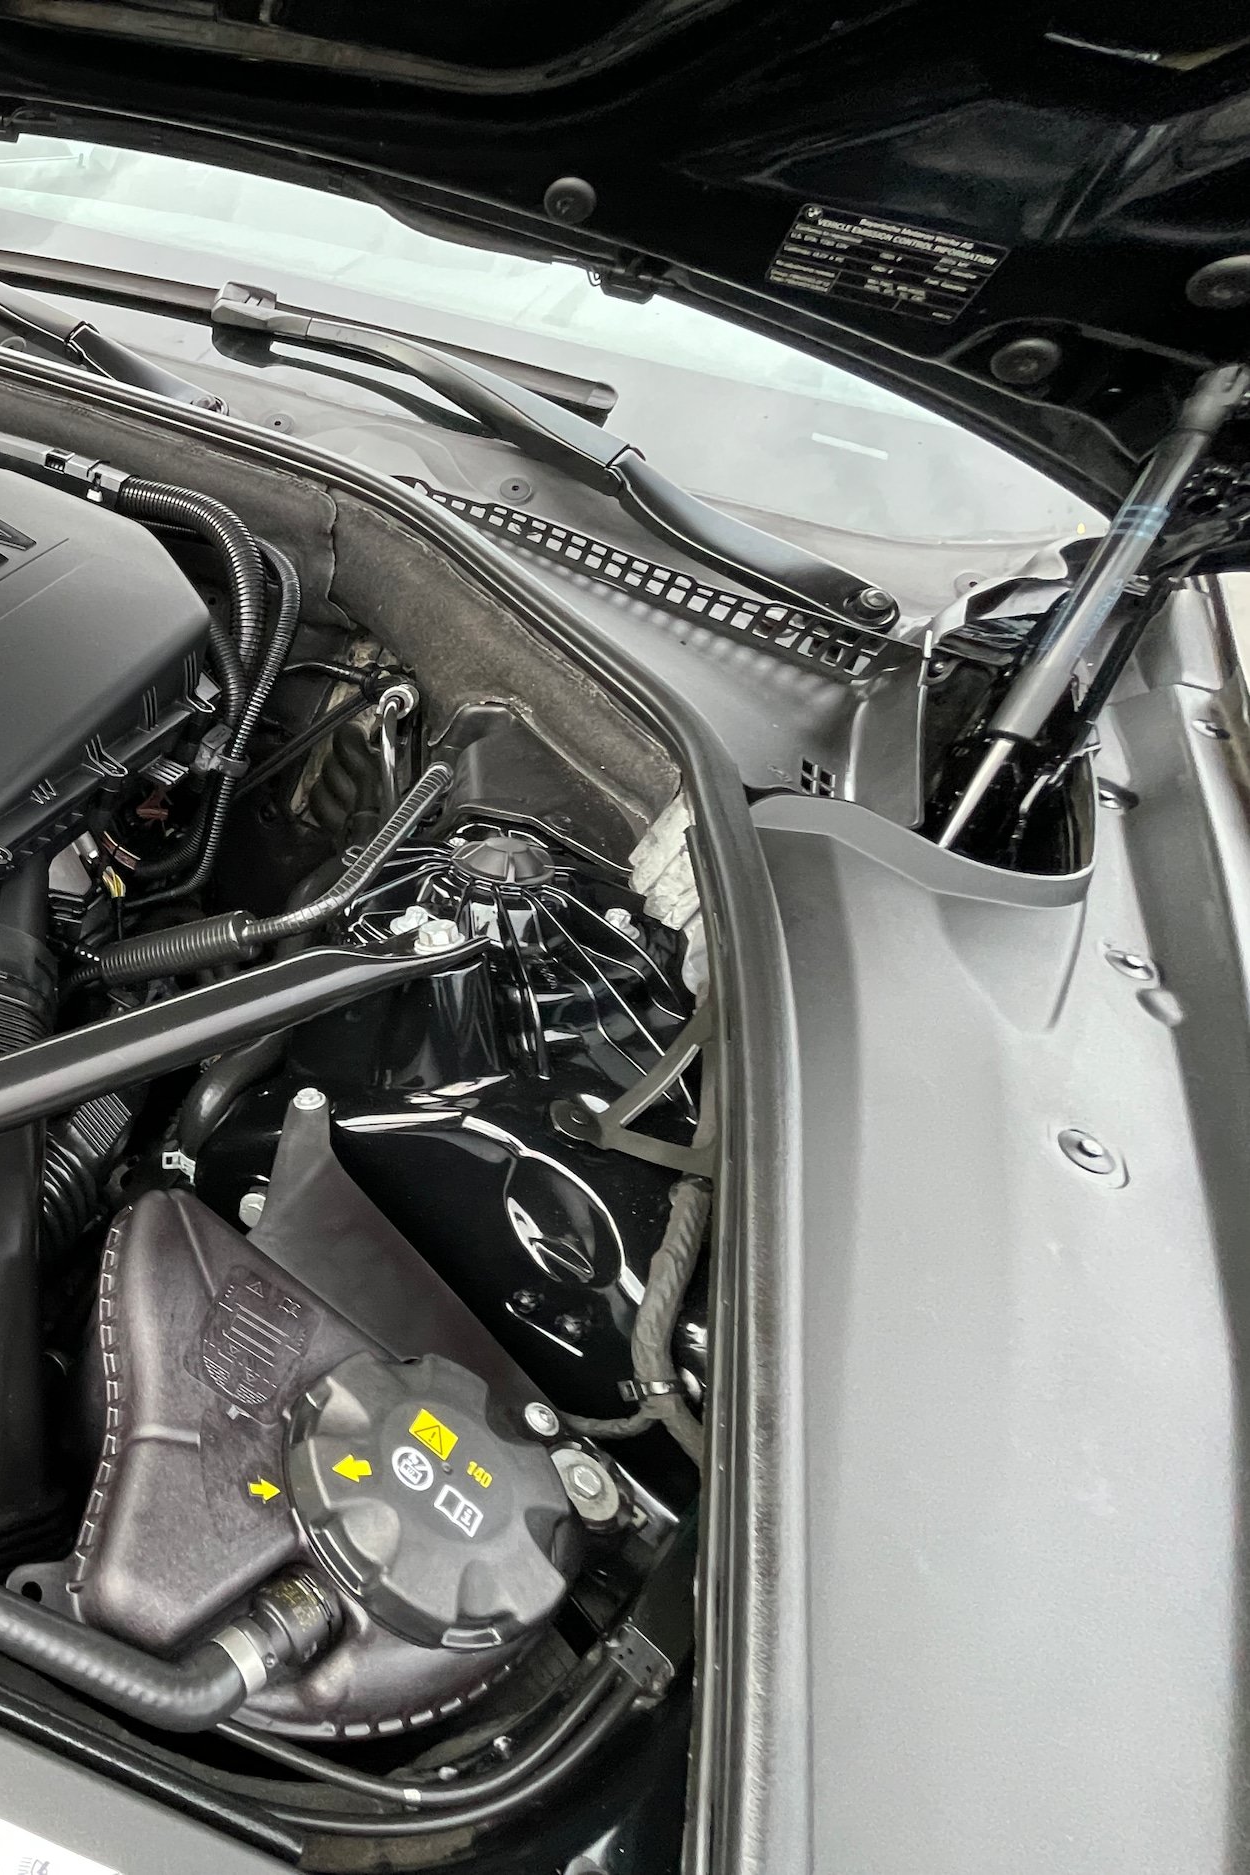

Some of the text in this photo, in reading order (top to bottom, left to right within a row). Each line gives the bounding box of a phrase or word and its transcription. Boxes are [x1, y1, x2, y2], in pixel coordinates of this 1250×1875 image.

[817, 218, 852, 233] VEHICLE
[892, 235, 934, 251] CONTROL
[933, 245, 998, 266] INFORMATION
[466, 1460, 493, 1489] 140
